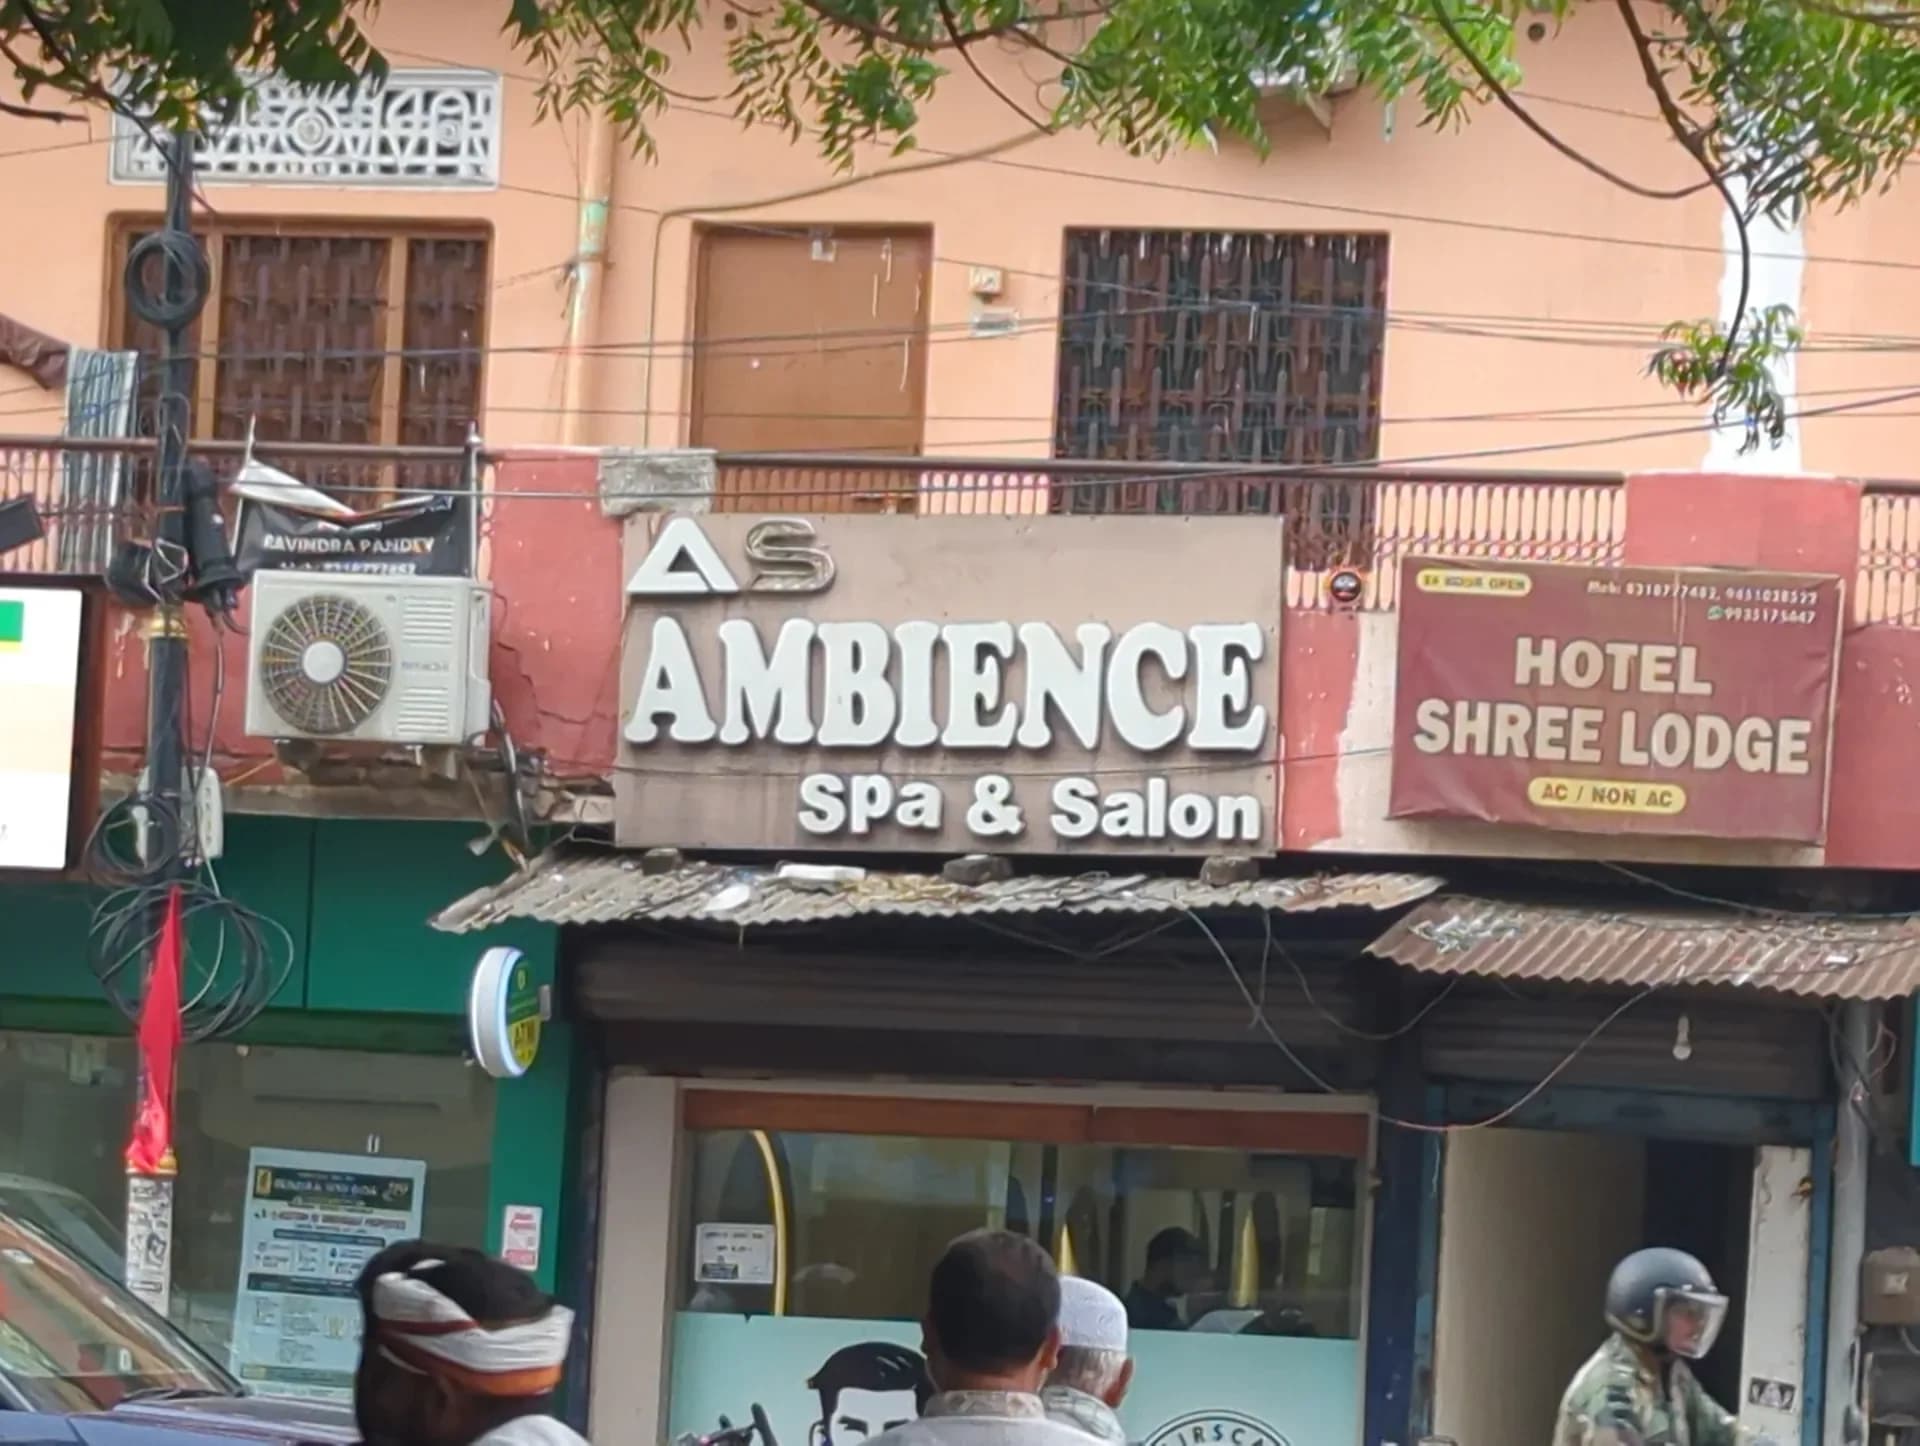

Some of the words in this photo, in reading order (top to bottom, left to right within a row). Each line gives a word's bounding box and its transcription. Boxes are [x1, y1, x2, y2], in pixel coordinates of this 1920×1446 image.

[265, 535, 355, 552] RAVINDRA
[360, 537, 435, 553] PANDEY
[1489, 578, 1527, 590] OPEN
[623, 616, 1267, 751] AMBIENCE
[1515, 636, 1712, 696] HOTEL
[1413, 697, 1604, 764] SHREE
[1620, 709, 1812, 776] LODGE
[798, 774, 944, 835] Spa
[966, 774, 1025, 837] &
[1051, 777, 1262, 841] Salon
[1541, 784, 1568, 800] AC
[1592, 787, 1637, 804] NON
[1646, 791, 1673, 807] AC
